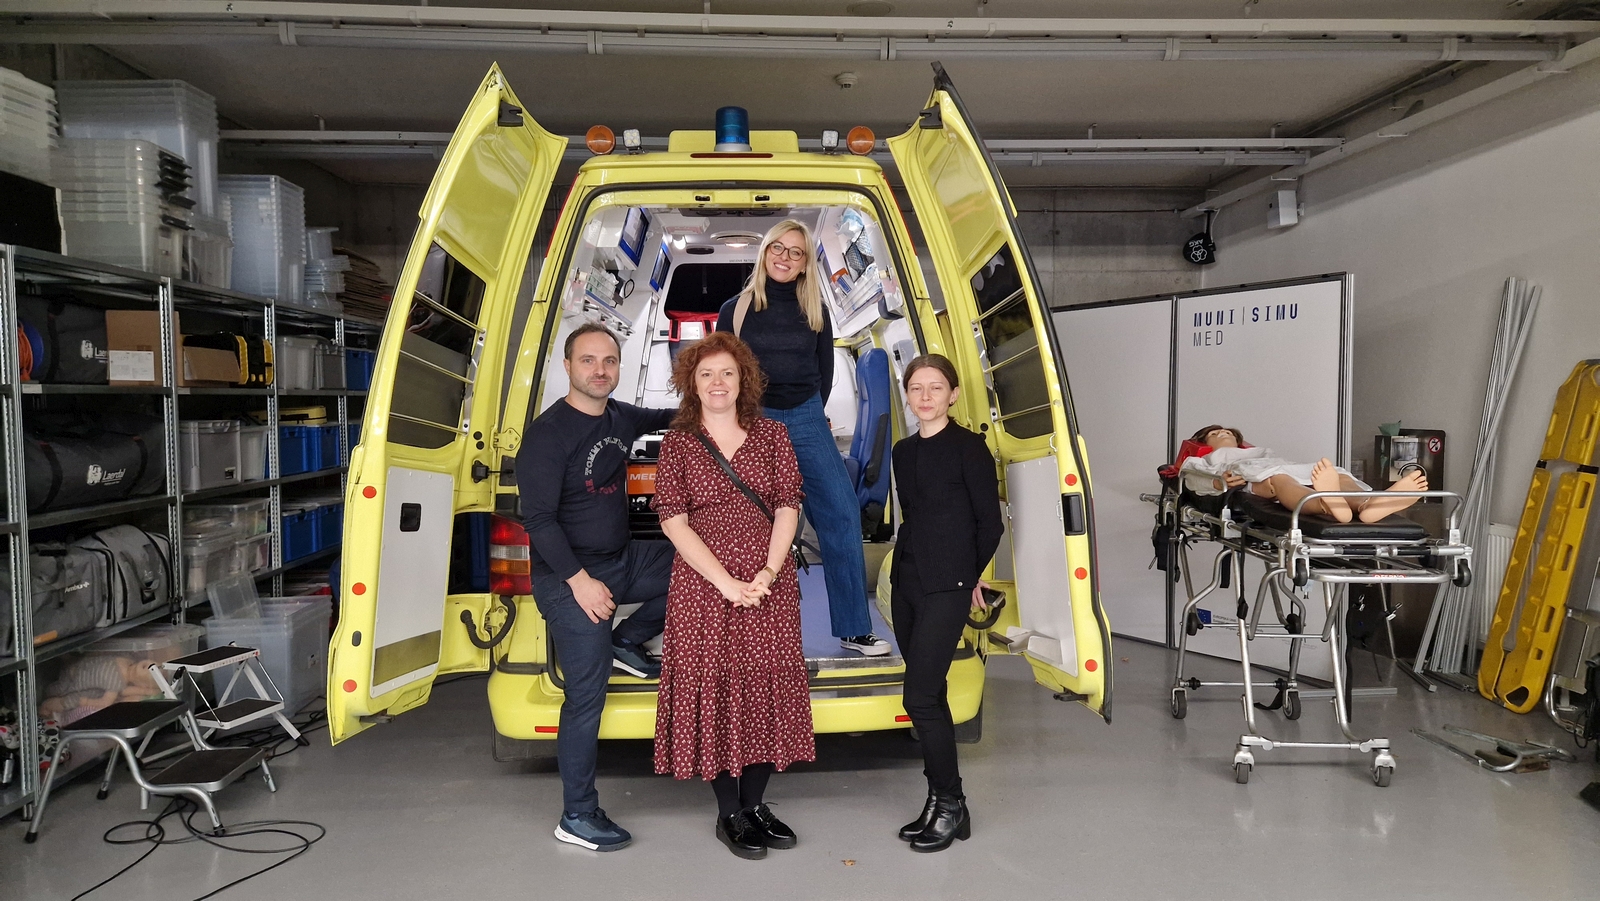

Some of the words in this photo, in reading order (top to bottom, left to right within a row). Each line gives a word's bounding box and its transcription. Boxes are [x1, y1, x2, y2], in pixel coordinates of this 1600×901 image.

[1193, 308, 1235, 328] MUNI
[1251, 303, 1298, 323] SIMU
[1193, 330, 1223, 347] MED
[585, 441, 603, 475] TOMMY
